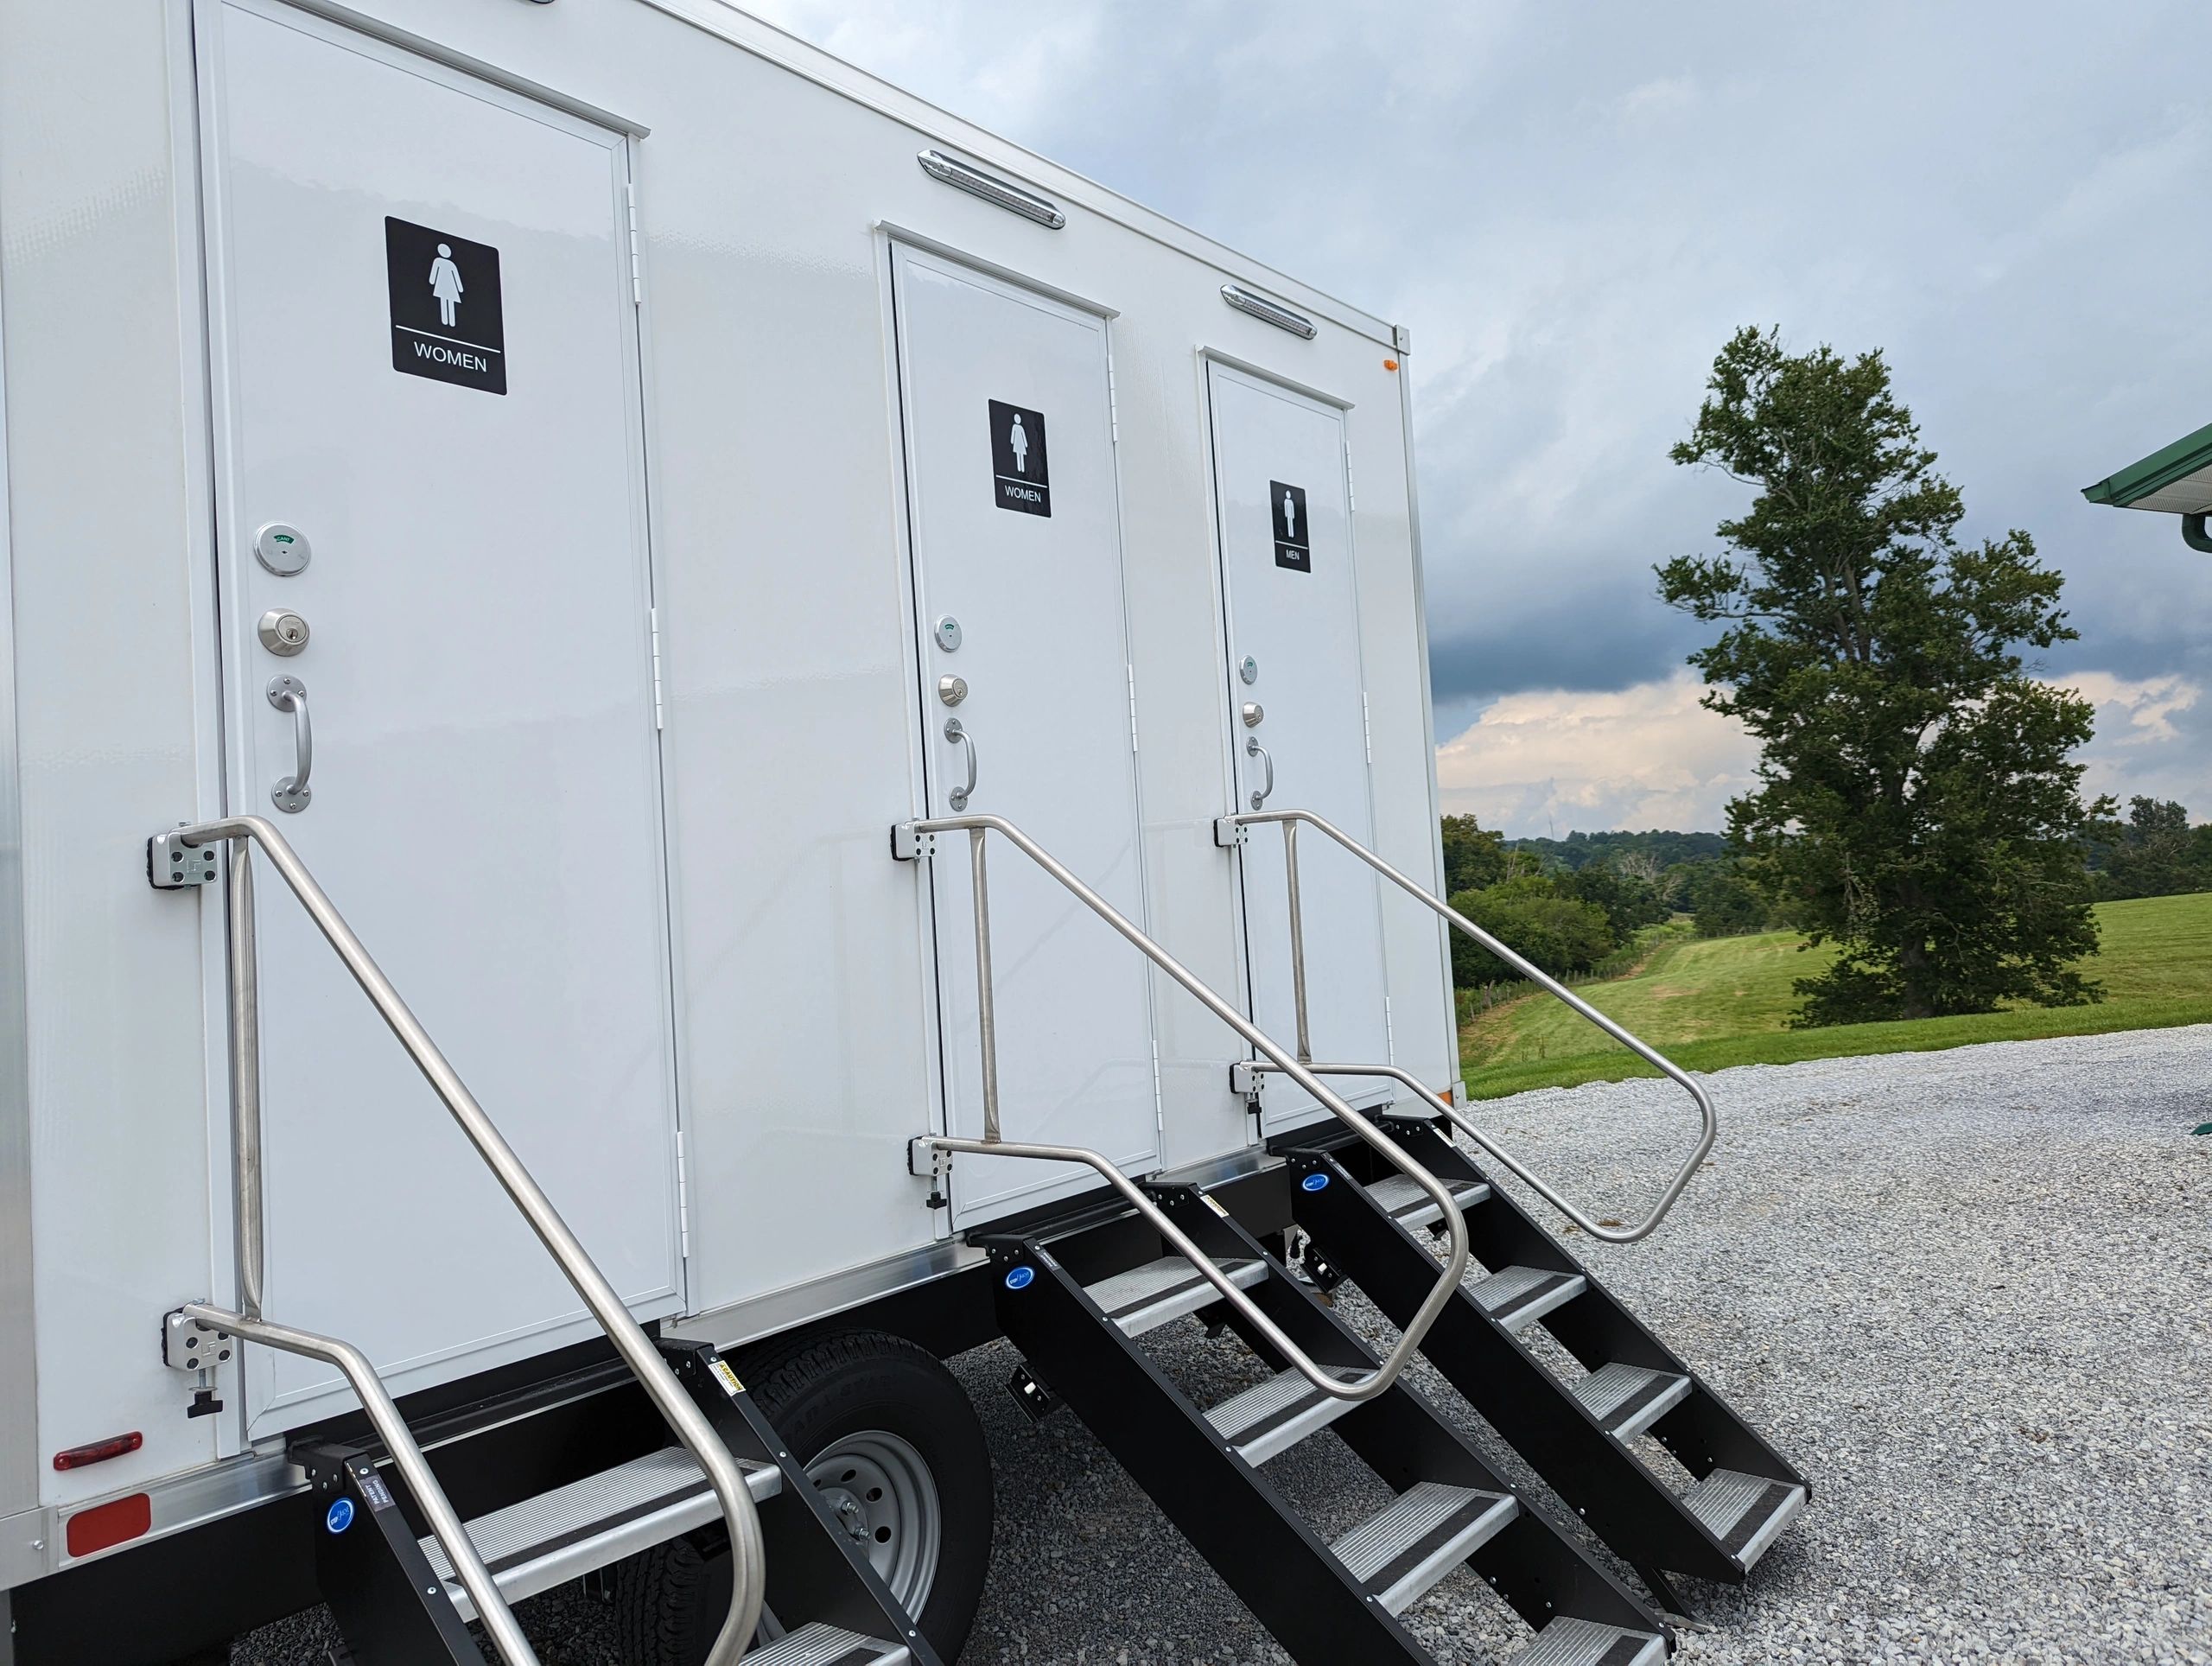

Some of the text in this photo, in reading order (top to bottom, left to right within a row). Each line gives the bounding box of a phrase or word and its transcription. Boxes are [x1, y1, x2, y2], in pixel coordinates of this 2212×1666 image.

[414, 341, 486, 372] WOMEN
[1005, 485, 1041, 502] WOMEN
[1286, 550, 1300, 560] MEN
[722, 1366, 742, 1390] CAUTION
[365, 1485, 380, 1504] PATENT
[372, 1479, 389, 1504] PENDING
